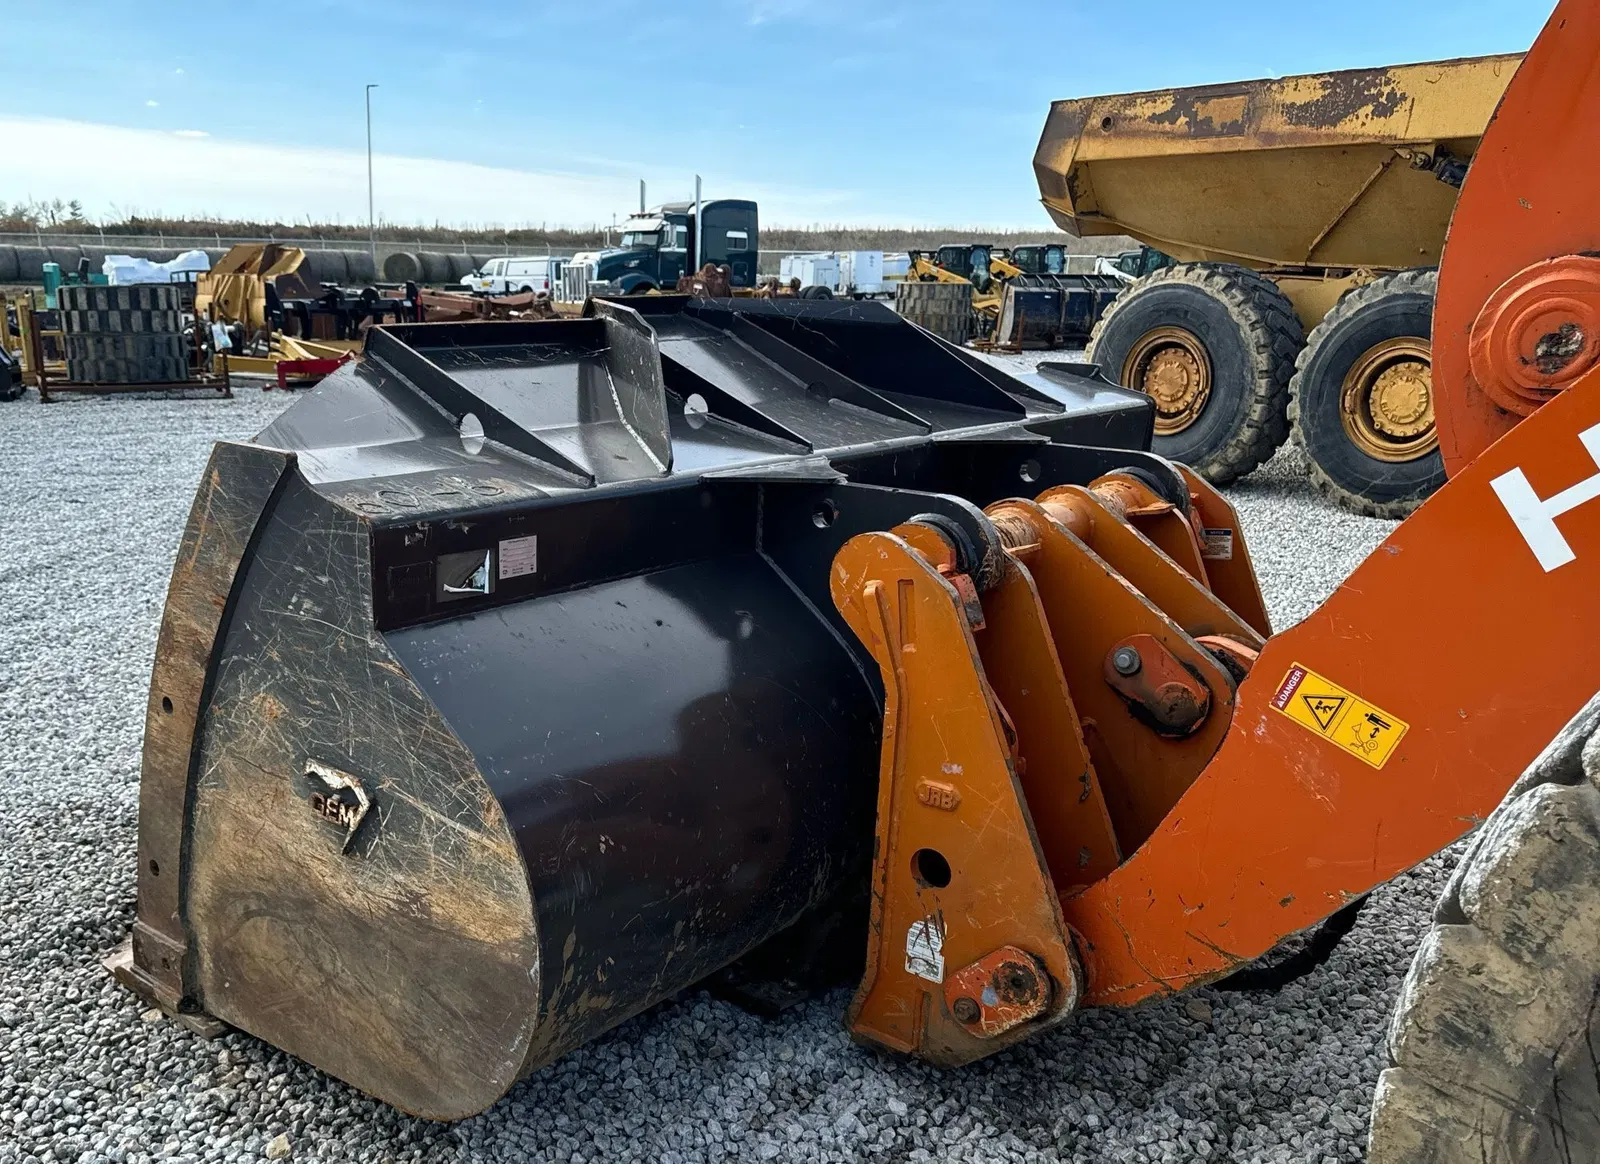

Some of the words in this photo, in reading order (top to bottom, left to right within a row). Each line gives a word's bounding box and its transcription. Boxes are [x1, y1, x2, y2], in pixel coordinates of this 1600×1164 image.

[1280, 669, 1303, 702] DANGER
[308, 792, 362, 831] GEM
[918, 784, 954, 809] JRB
